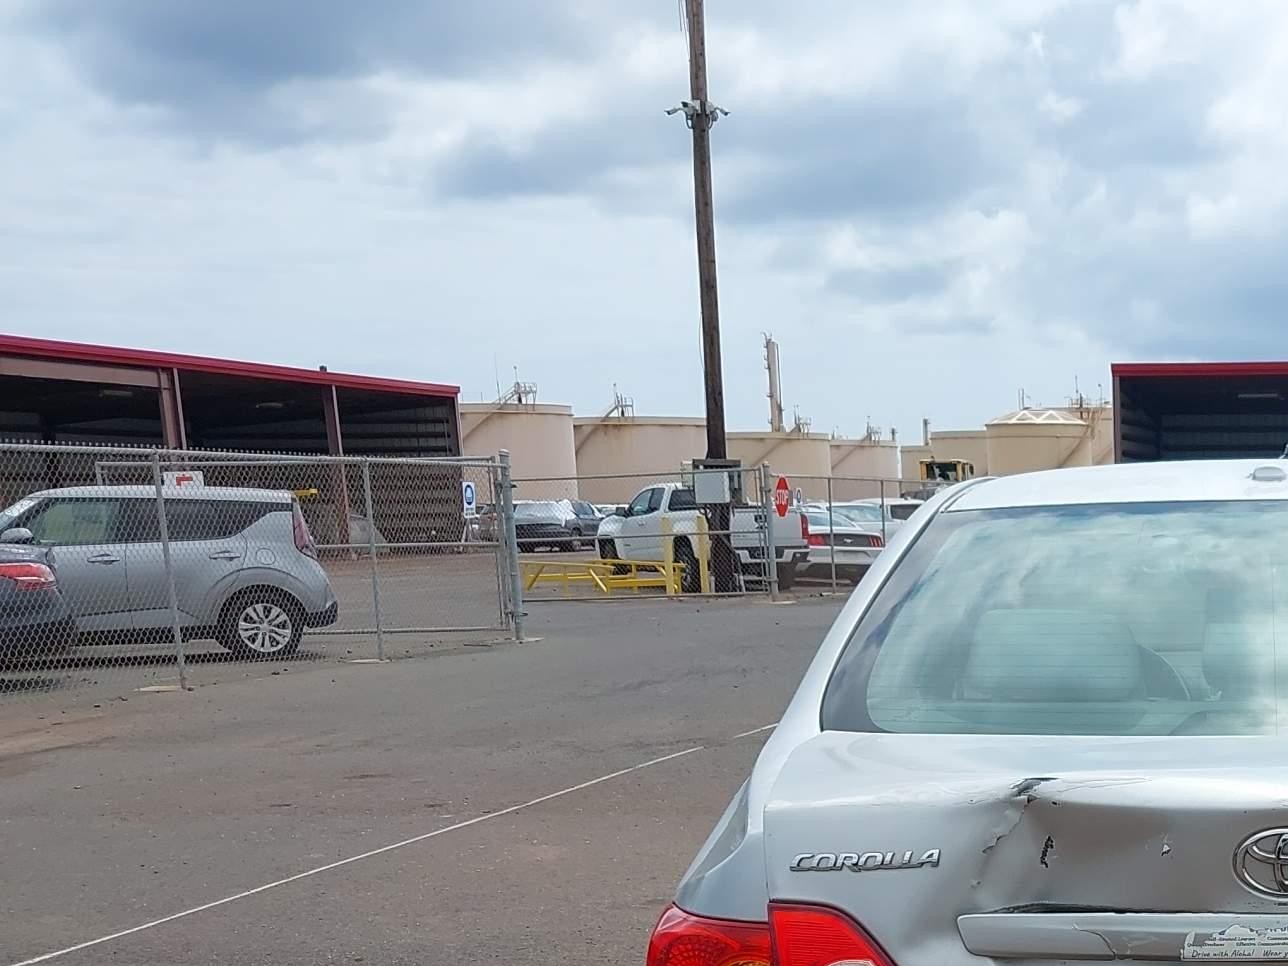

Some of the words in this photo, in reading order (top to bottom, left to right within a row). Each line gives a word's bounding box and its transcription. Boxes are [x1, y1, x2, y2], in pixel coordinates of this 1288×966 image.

[776, 491, 788, 505] STOP
[790, 849, 941, 872] COROLLA
[1191, 949, 1211, 958] Drive
[1230, 949, 1255, 957] Aloha!
[1263, 948, 1282, 957] Wear
